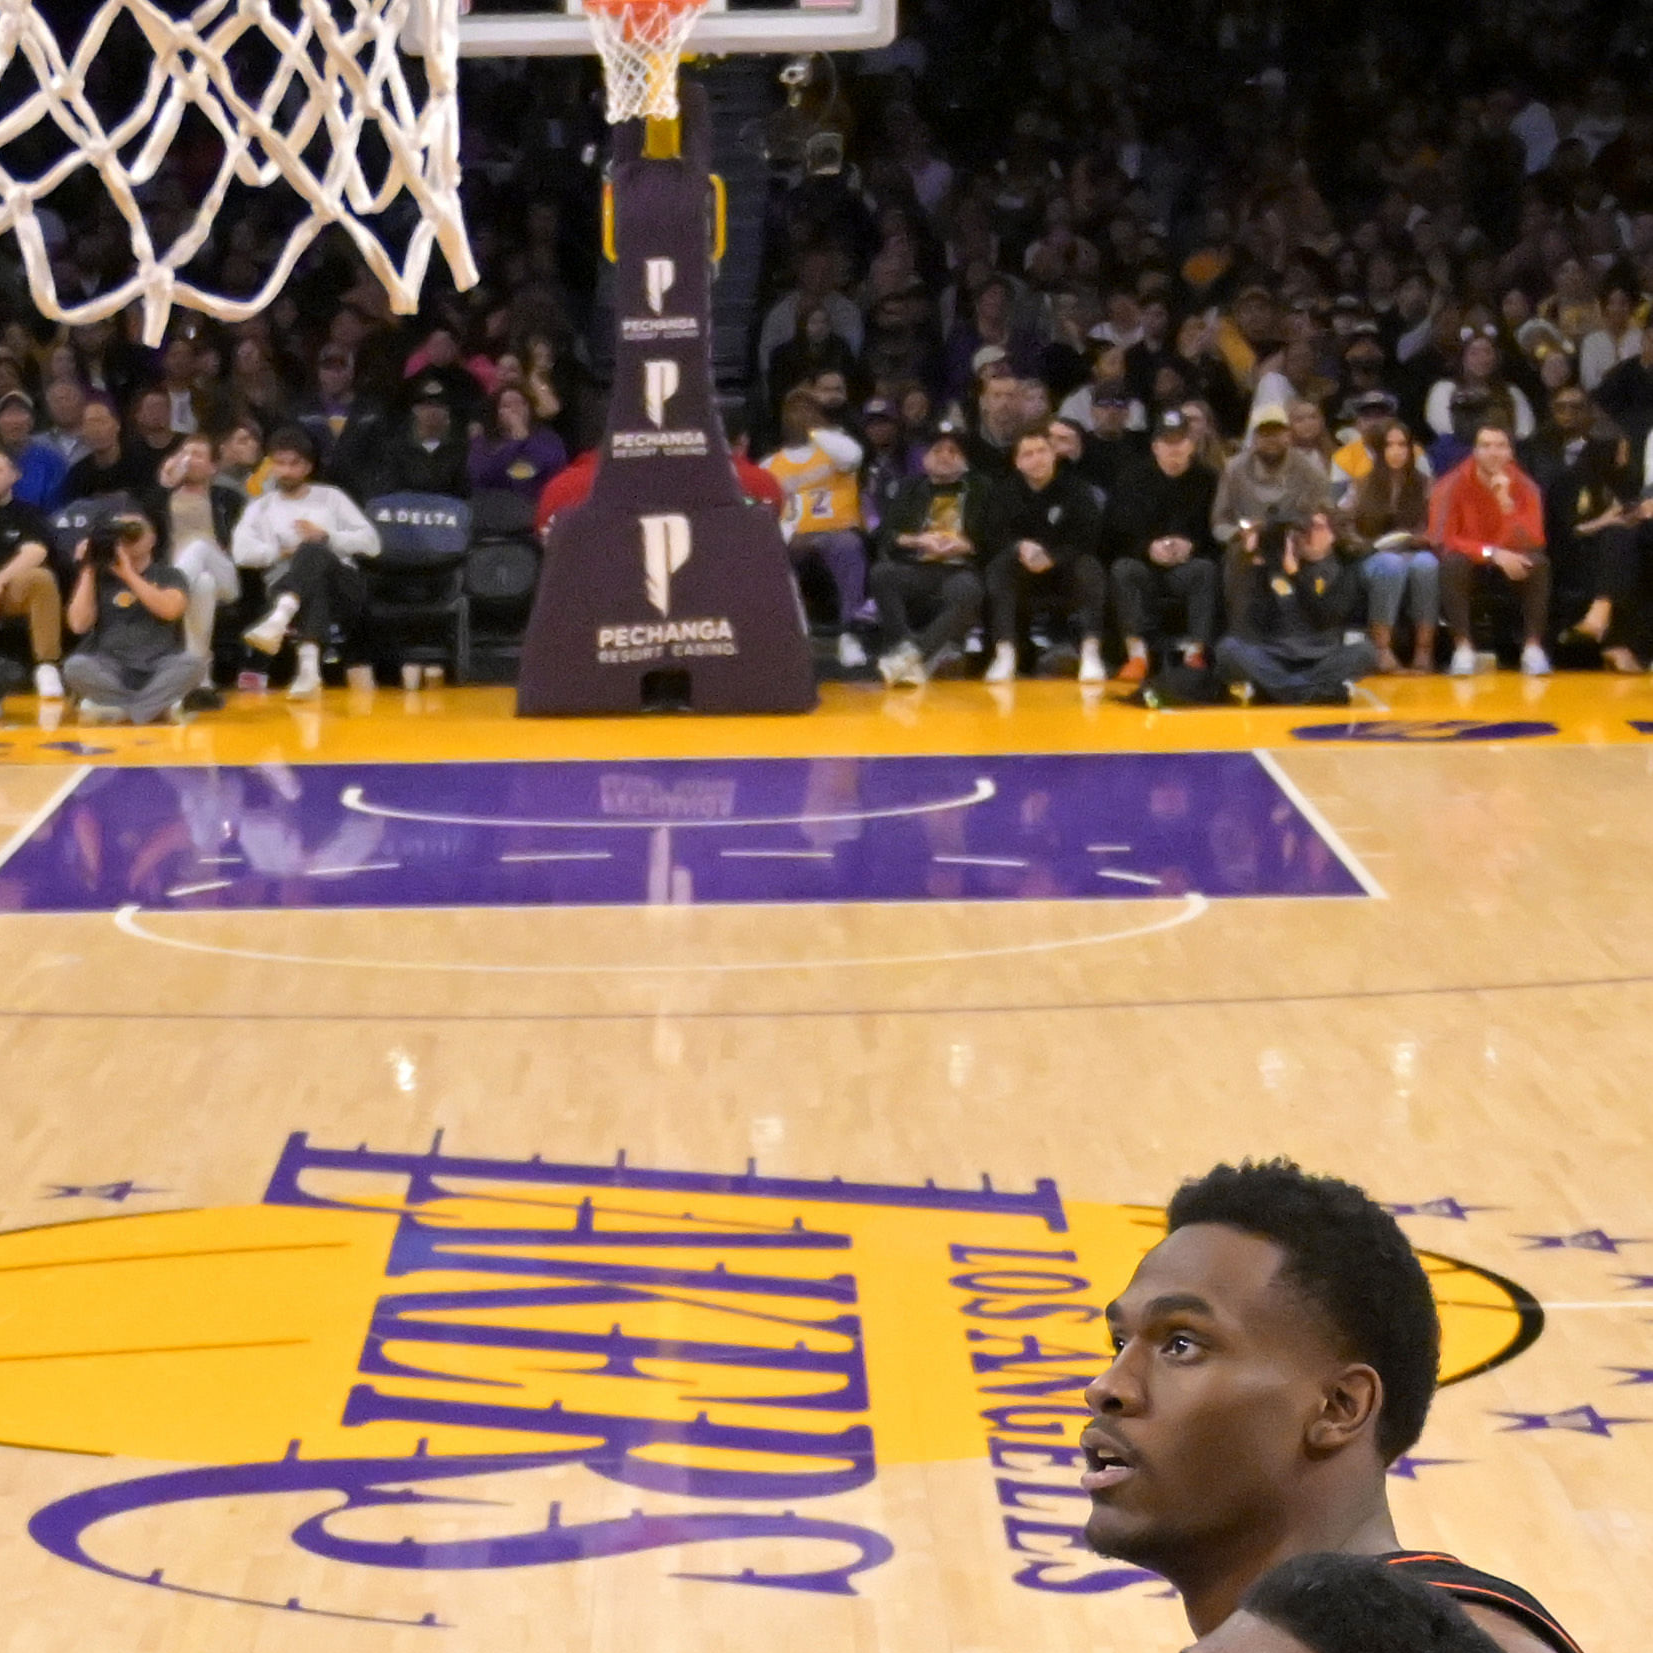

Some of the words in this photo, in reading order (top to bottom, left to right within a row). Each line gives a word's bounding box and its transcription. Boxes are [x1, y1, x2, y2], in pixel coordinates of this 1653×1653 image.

[612, 431, 707, 447] PECHANGA
[398, 510, 457, 527] DELTA
[598, 620, 734, 648] PECHANGA
[948, 1242, 1106, 1324] LOS
[27, 1126, 1070, 1629] LAKERS
